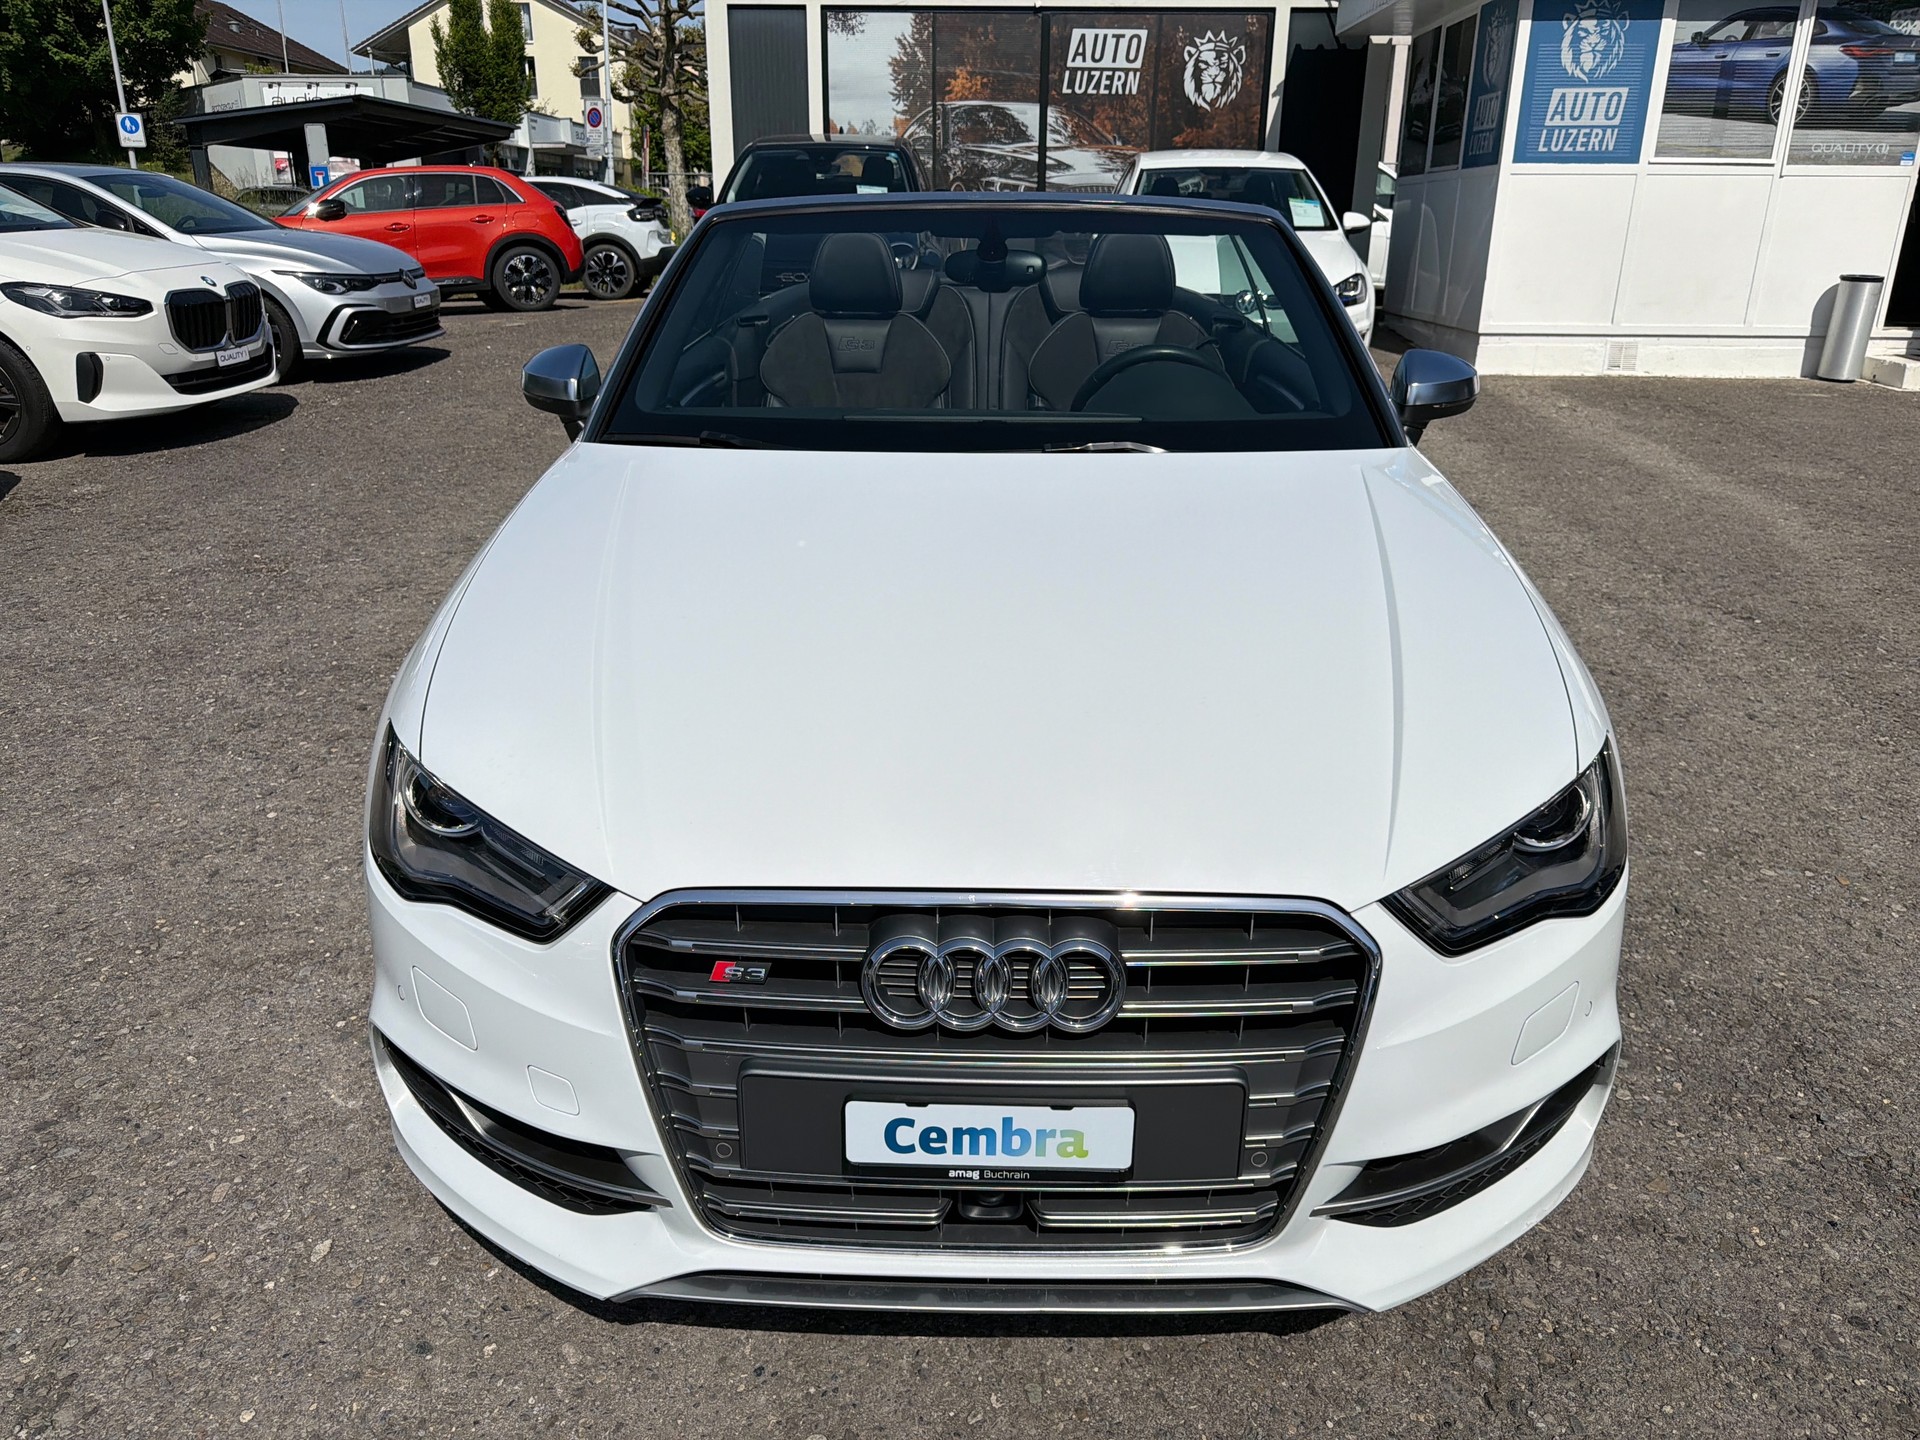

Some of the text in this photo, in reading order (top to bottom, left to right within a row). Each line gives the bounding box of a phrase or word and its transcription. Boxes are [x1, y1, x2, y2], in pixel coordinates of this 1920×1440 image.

[1071, 33, 1142, 64] AUTO
[1062, 70, 1140, 95] LUZERN
[1549, 91, 1623, 121] AUTO
[1538, 128, 1618, 152] LUZERN
[1811, 143, 1877, 154] QUALITY
[721, 965, 767, 982] S3
[884, 1116, 1089, 1159] Cembra
[948, 1169, 1030, 1180] amag Buchrain
